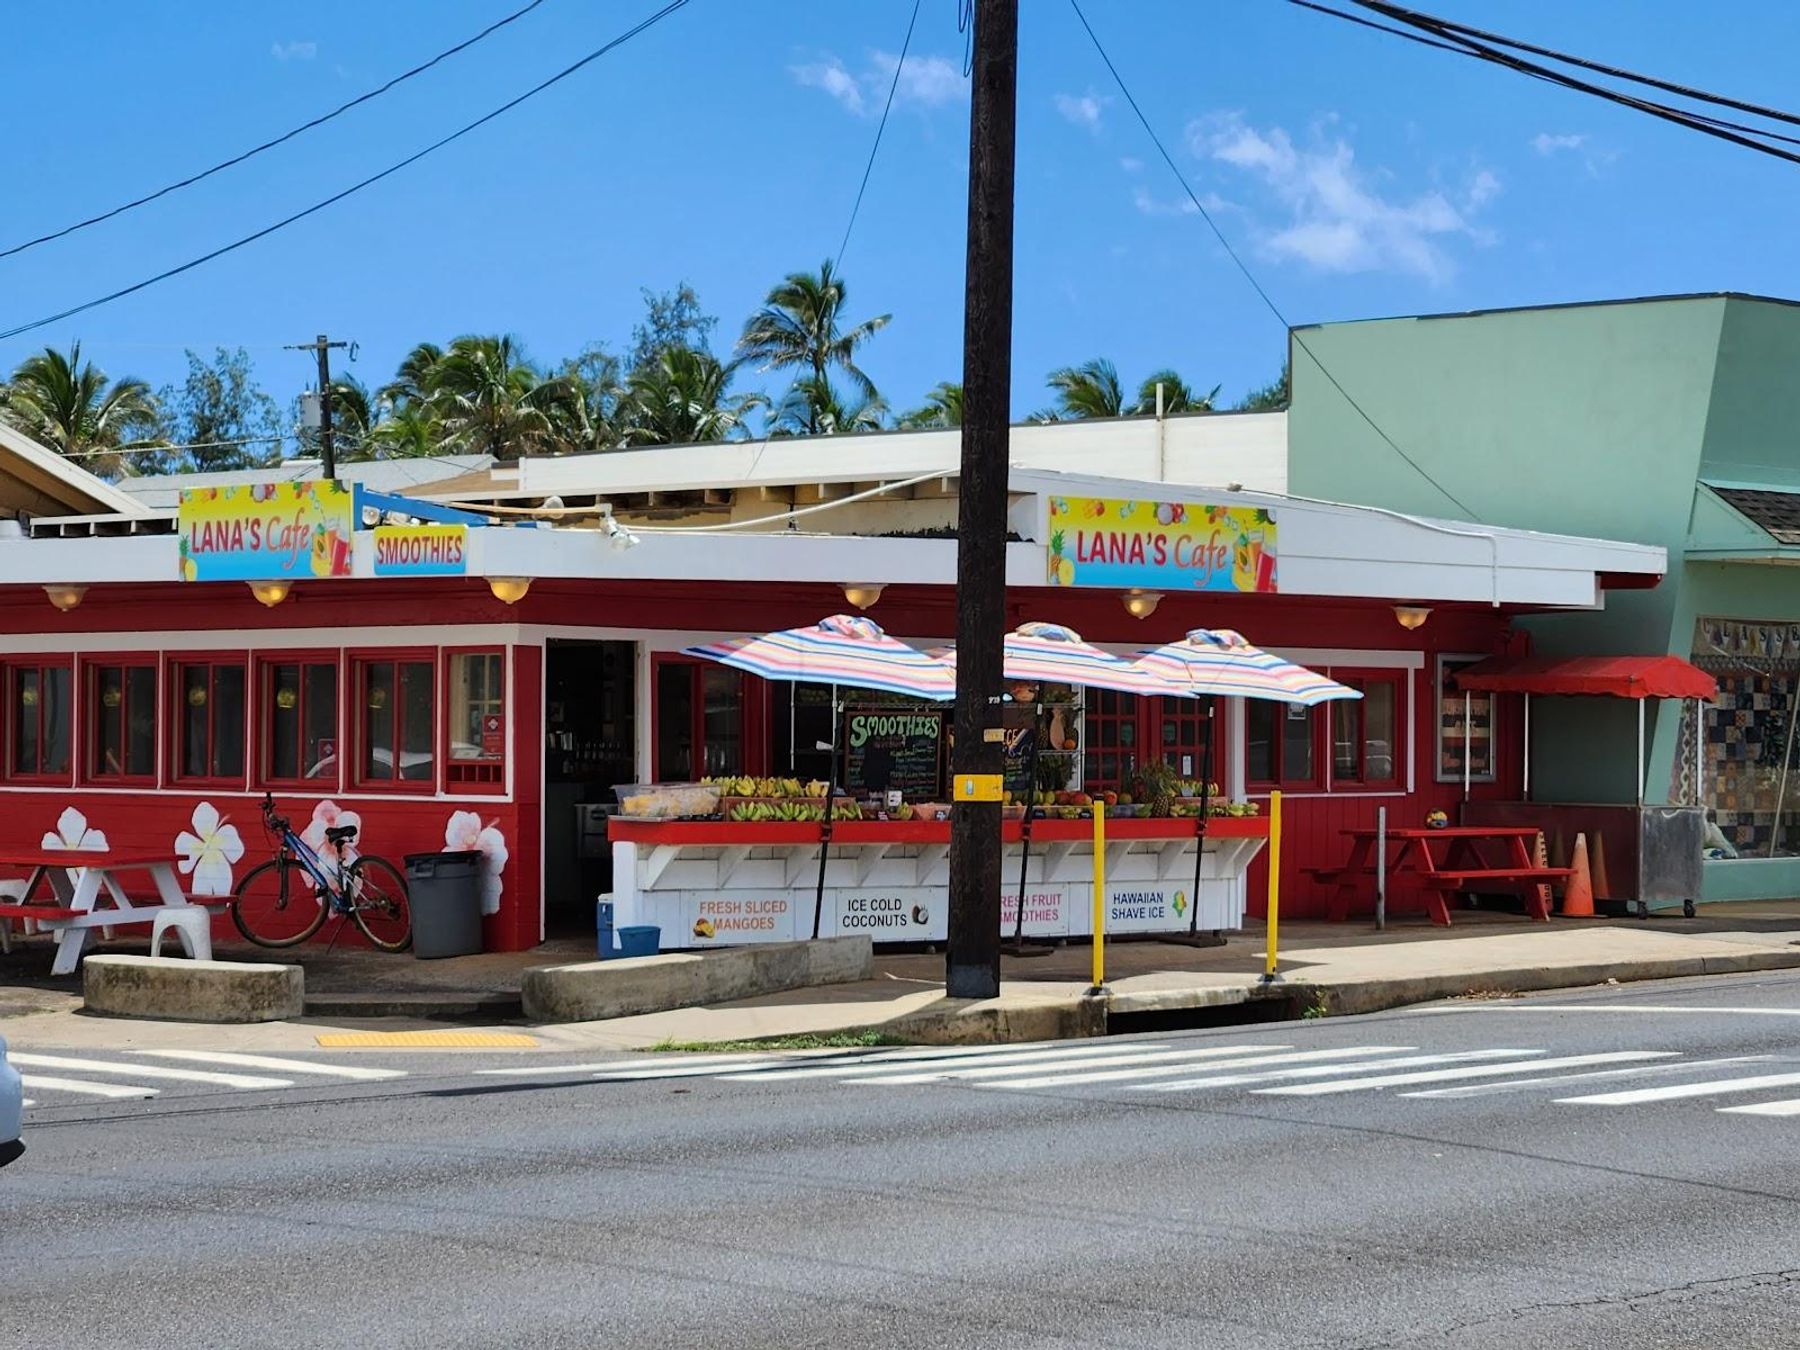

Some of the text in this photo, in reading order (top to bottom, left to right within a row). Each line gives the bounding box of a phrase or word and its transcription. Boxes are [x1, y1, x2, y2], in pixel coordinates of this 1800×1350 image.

[192, 506, 310, 570] LANA'S Cafe
[377, 535, 462, 564] SMOOTHIES
[1077, 528, 1228, 587] LANA'S Cafe
[850, 715, 939, 747] SMOOTHIES
[848, 898, 903, 912] ICE COLD
[1001, 894, 1062, 908] RESH FRUIT
[1113, 892, 1164, 905] HAWAIIAN
[700, 900, 788, 914] FRESH SLICED
[1111, 906, 1165, 920] SHAVE ICE
[713, 917, 775, 931] MANGOES
[842, 914, 907, 928] COCONUTS
